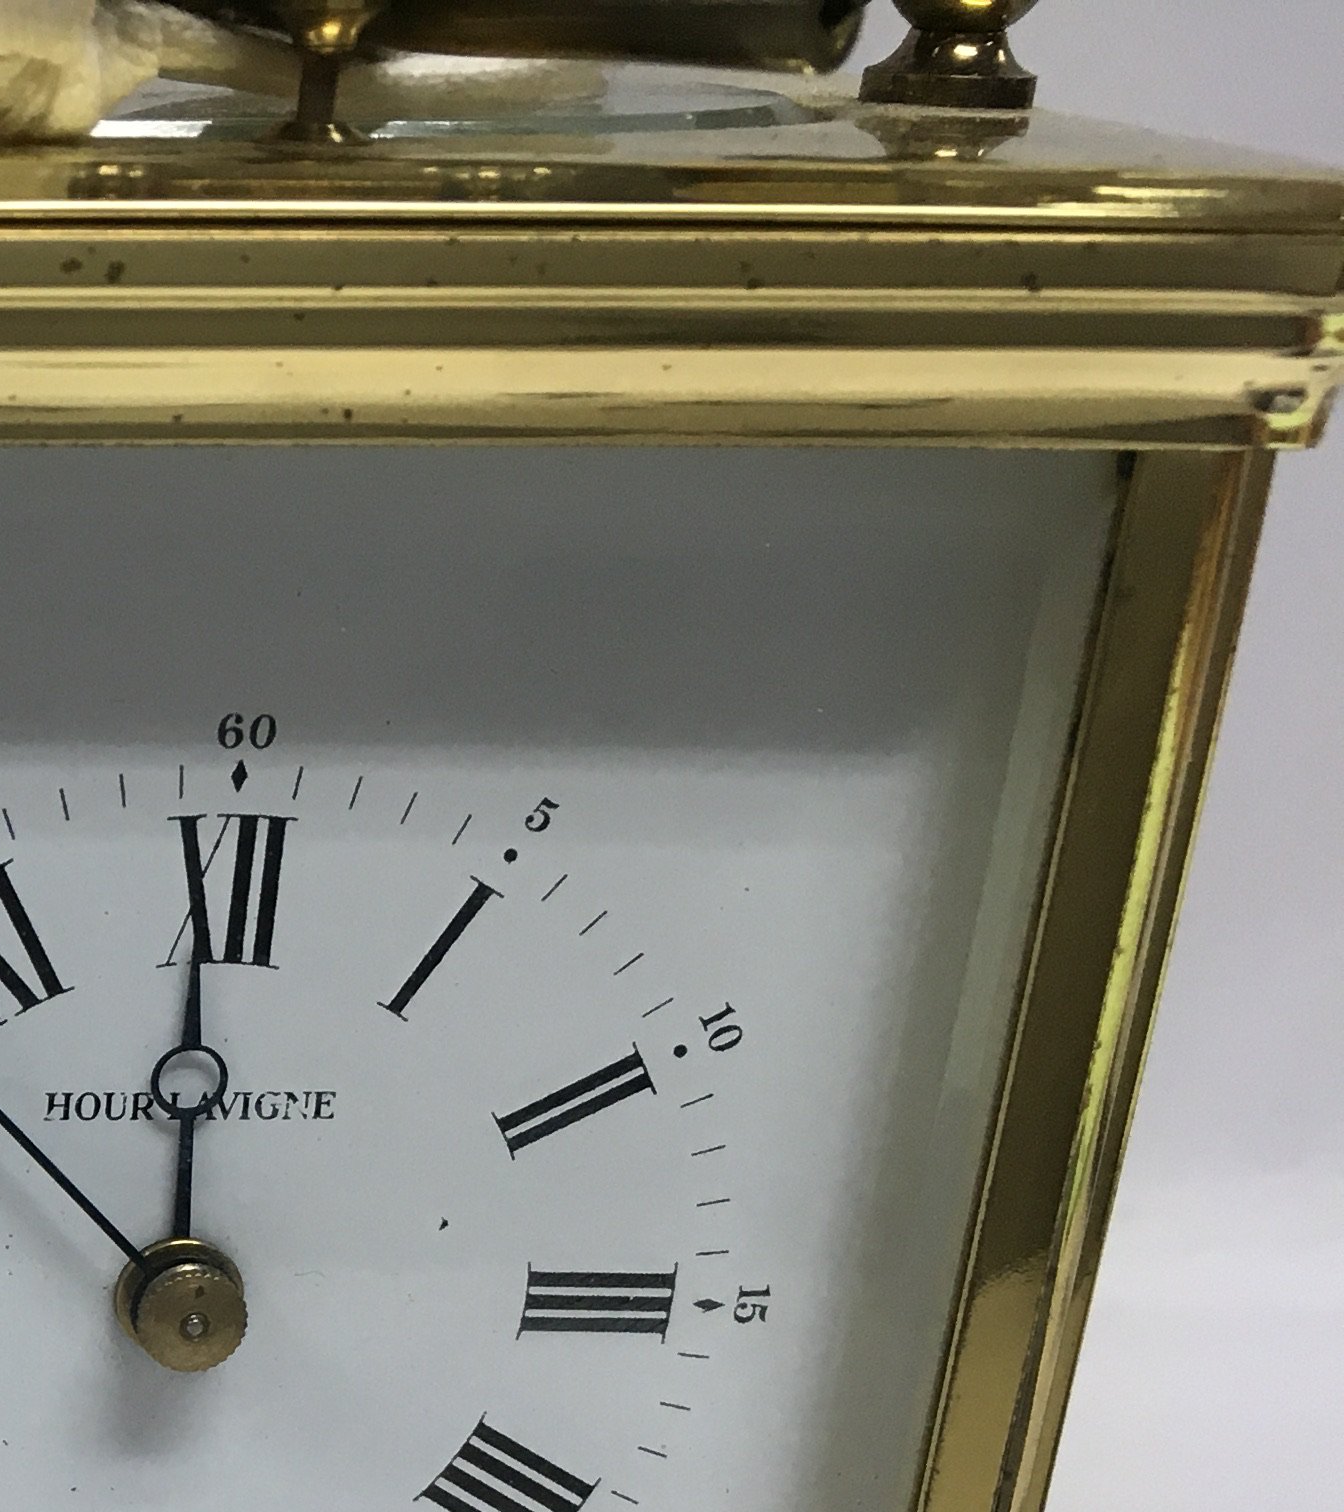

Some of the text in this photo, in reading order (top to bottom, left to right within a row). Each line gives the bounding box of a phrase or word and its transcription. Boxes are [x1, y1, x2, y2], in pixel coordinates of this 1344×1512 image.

[217, 713, 277, 749] 60
[524, 797, 560, 833] 5
[156, 813, 298, 970] XII
[376, 875, 505, 1022] I
[698, 1001, 743, 1053] 10
[43, 1091, 154, 1121] HOUR
[490, 1042, 657, 1160] II
[516, 1261, 678, 1344] III
[733, 1284, 771, 1324] 15
